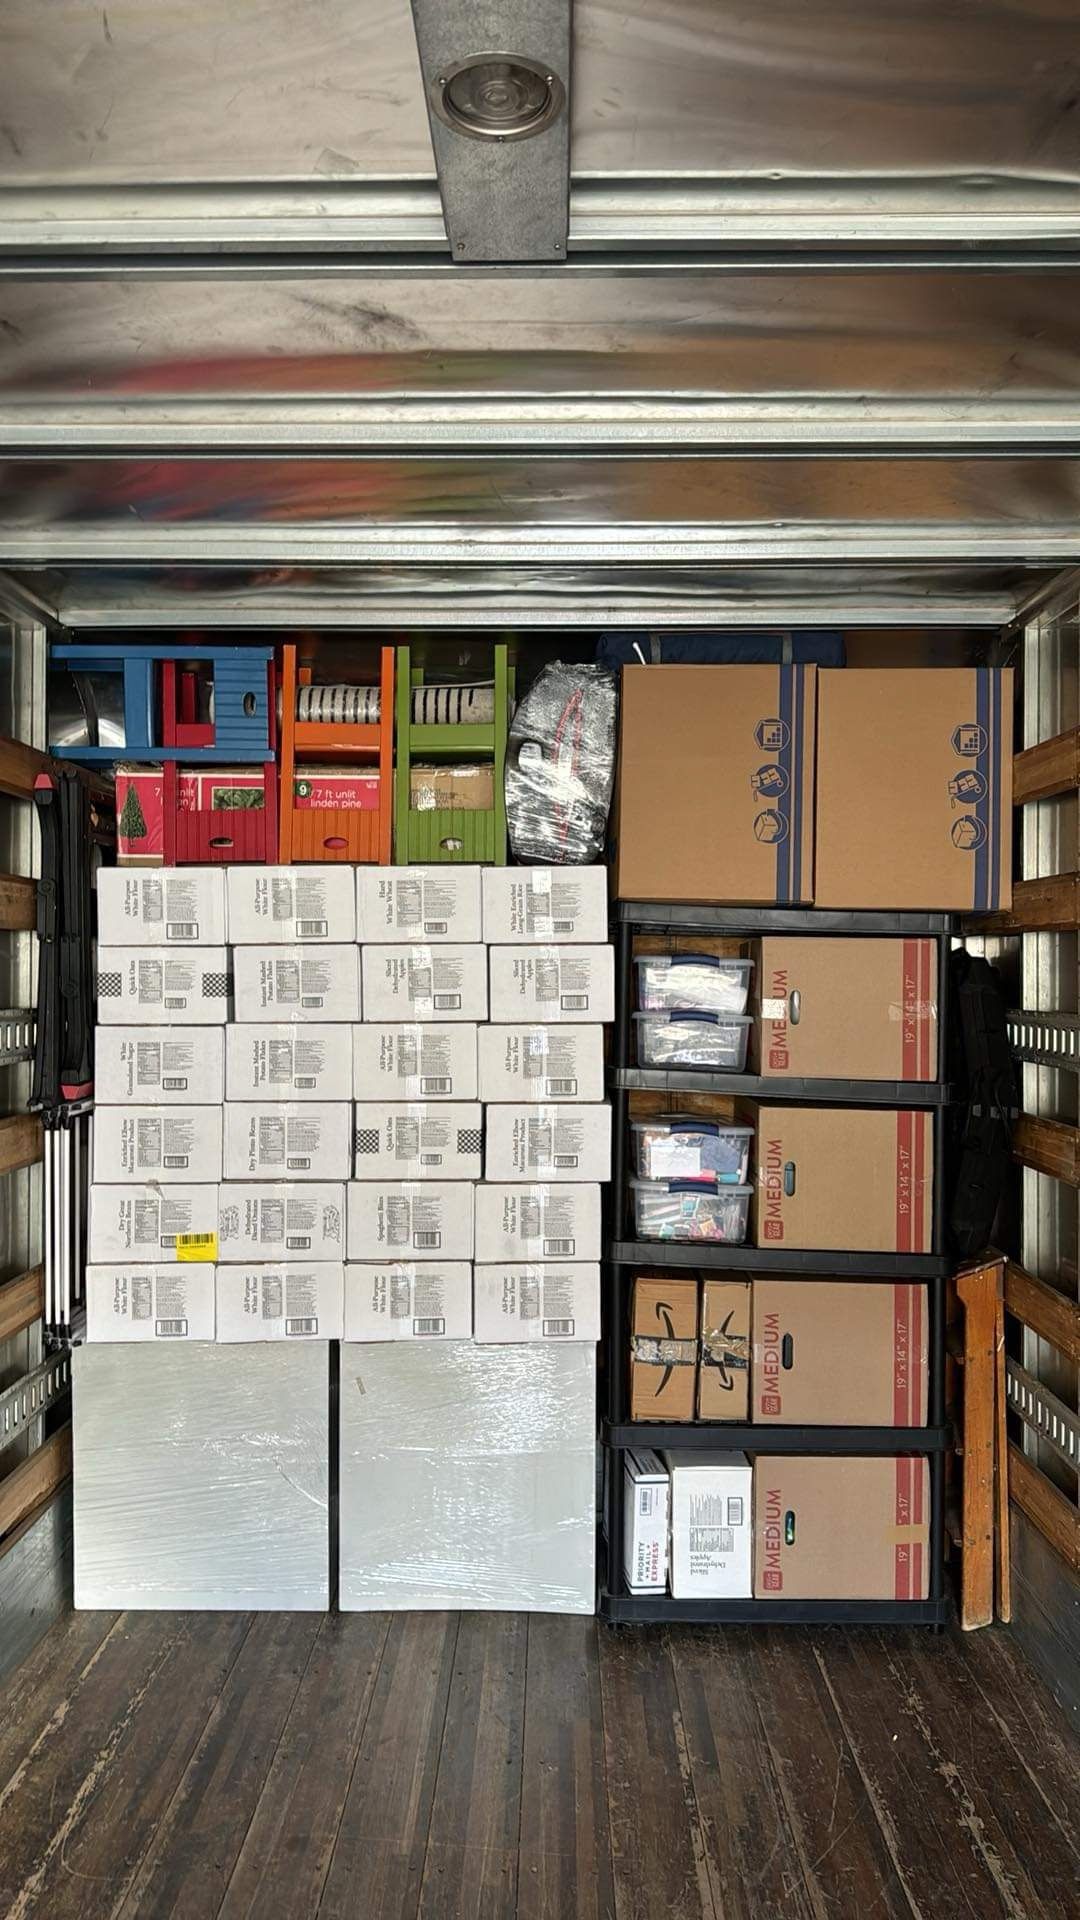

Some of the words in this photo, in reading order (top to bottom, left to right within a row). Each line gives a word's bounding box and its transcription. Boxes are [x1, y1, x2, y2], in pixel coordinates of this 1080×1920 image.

[154, 787, 161, 797] 7
[299, 784, 307, 796] 9
[316, 789, 323, 799] 7
[325, 789, 333, 799] ft
[335, 789, 357, 799] unlit
[310, 800, 339, 808] linden
[341, 800, 362, 809] pine
[129, 975, 137, 996] Quick
[905, 974, 915, 989] 17"
[772, 970, 788, 1048] MEUM
[905, 1028, 915, 1043] 19"
[899, 1145, 910, 1159] 17"
[767, 1140, 782, 1218] MEDIUM
[899, 1172, 909, 1187] 14"
[899, 1199, 909, 1214] 19"
[764, 1313, 779, 1393] MEDIUM
[897, 1345, 906, 1361] 14"
[897, 1373, 906, 1389] 19"
[898, 1493, 908, 1508] 17"
[766, 1489, 781, 1569] MEDIUM
[637, 1542, 645, 1582] PRIORITY
[651, 1542, 659, 1582] EXPRESS
[690, 1554, 712, 1562] Apples
[898, 1547, 908, 1562] 19"
[690, 1561, 726, 1569] Dehydrated
